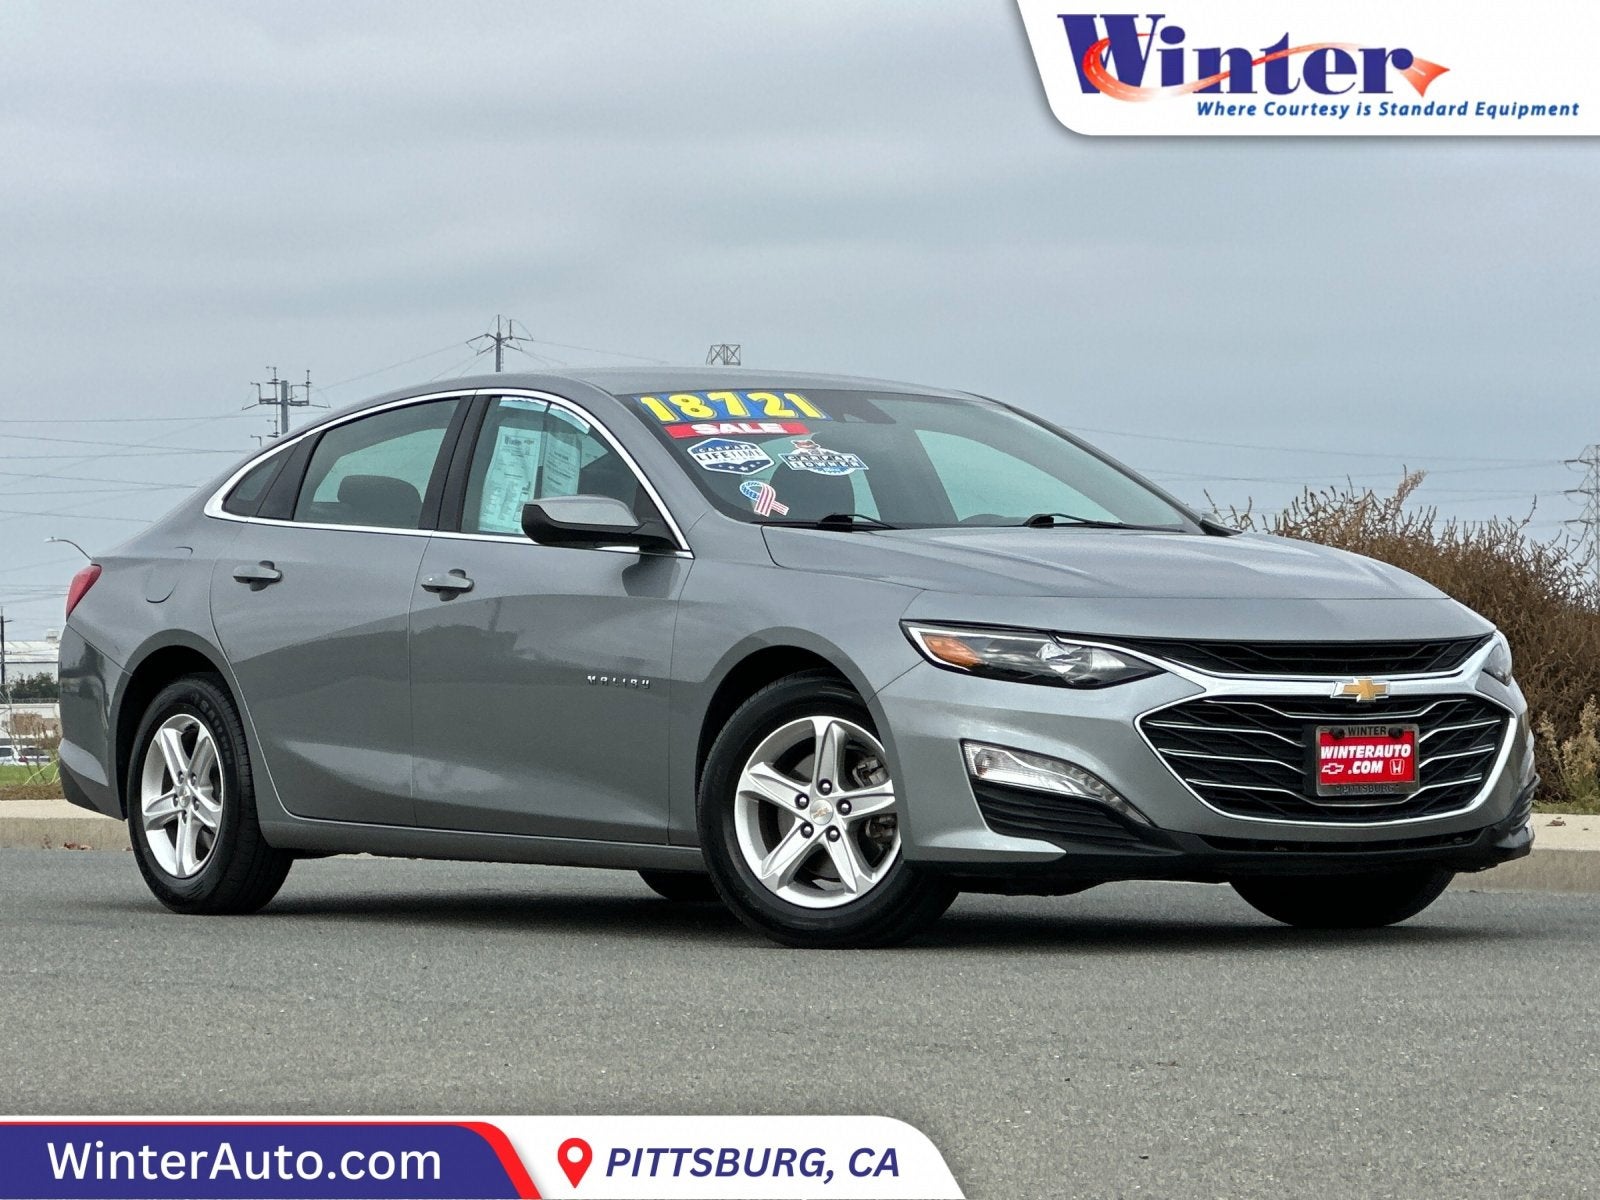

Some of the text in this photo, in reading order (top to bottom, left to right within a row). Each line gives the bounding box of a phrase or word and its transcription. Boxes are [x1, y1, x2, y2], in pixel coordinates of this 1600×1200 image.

[640, 391, 827, 422] 18721
[691, 422, 788, 436] SALE
[696, 449, 764, 461] LIFETIME
[1347, 726, 1387, 736] WINTER
[1320, 744, 1411, 759] WINTERAUTO
[1347, 760, 1384, 775] .COM
[1342, 785, 1394, 793] PITTSBURG
